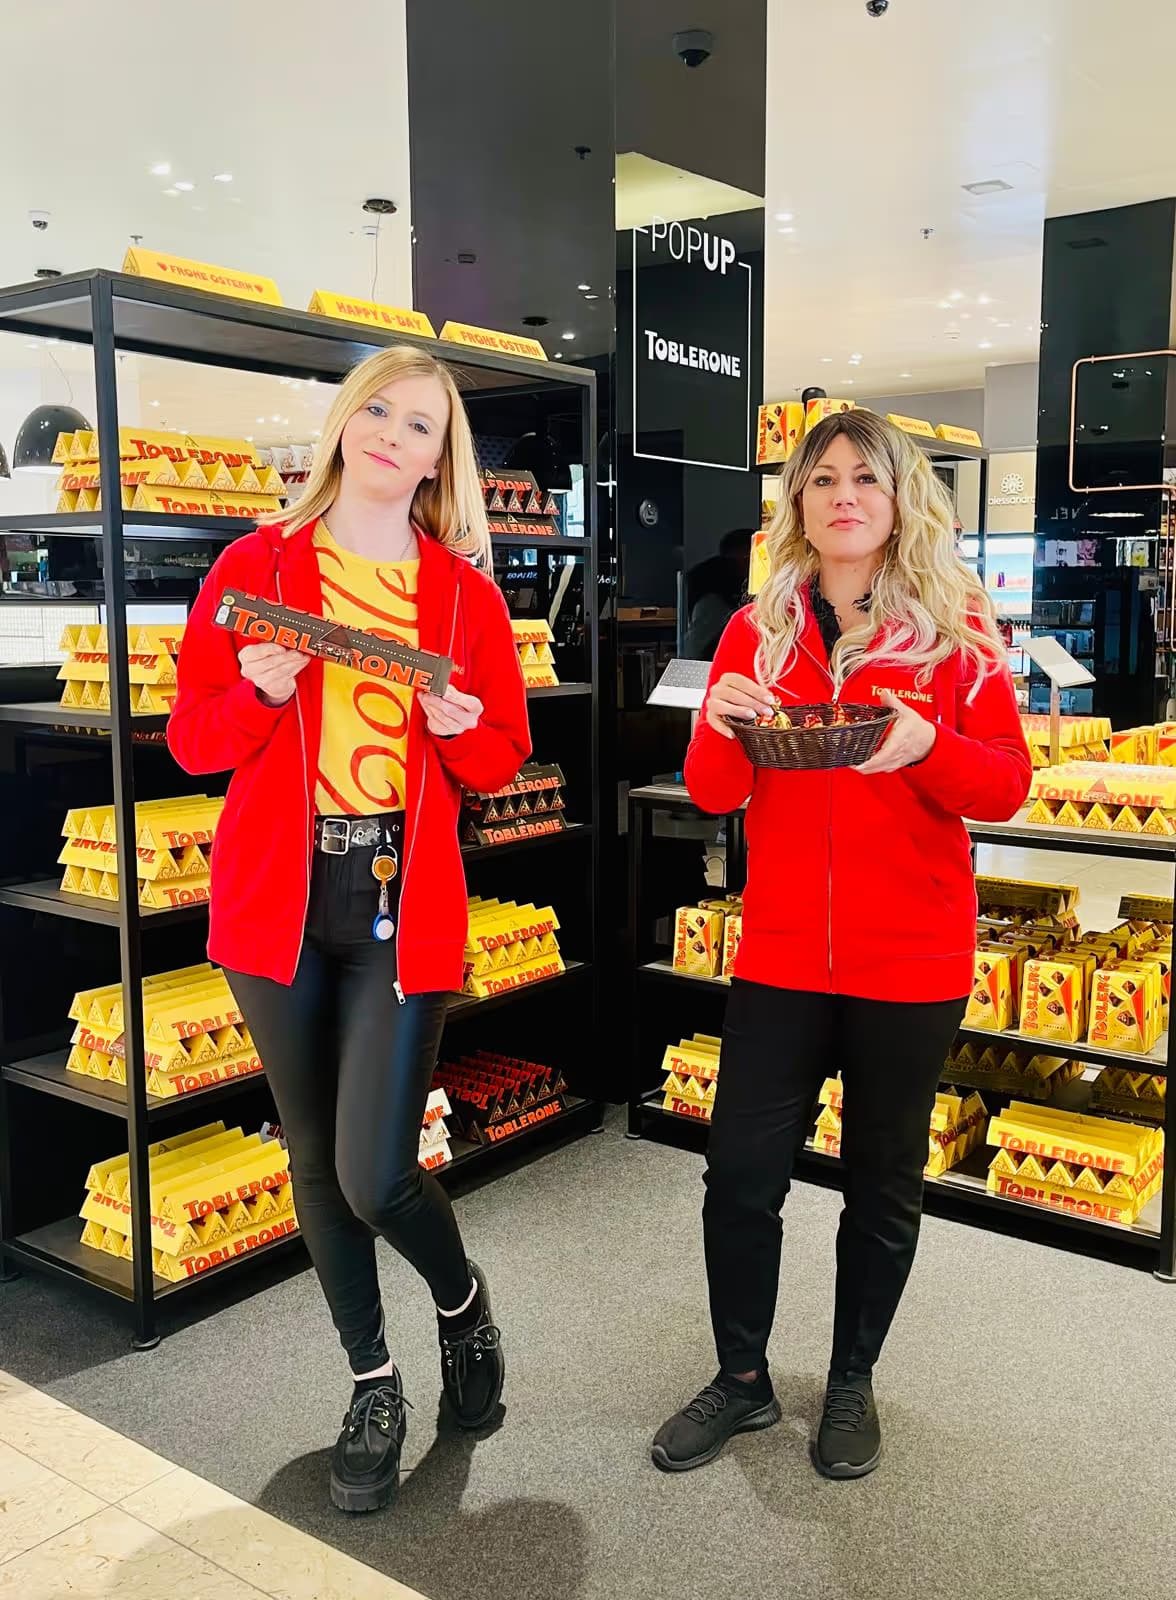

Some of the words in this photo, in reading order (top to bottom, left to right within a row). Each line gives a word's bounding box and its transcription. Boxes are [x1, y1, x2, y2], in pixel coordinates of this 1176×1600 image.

[652, 215, 736, 274] POPUP
[336, 302, 378, 321] HAPPY
[381, 312, 421, 330] B-DAY
[645, 330, 740, 378] TOBLERONE
[482, 819, 562, 844] TOBLERONE
[477, 921, 554, 951] TOBLERONE
[481, 962, 559, 995] TOBLERONE
[484, 1101, 562, 1142] TOBLERONE
[997, 1131, 1126, 1171] TOBLERONE
[183, 1169, 292, 1219] TOBLERON
[997, 1176, 1122, 1222] TOBLERONE
[180, 1217, 298, 1276] TOBLERONE
